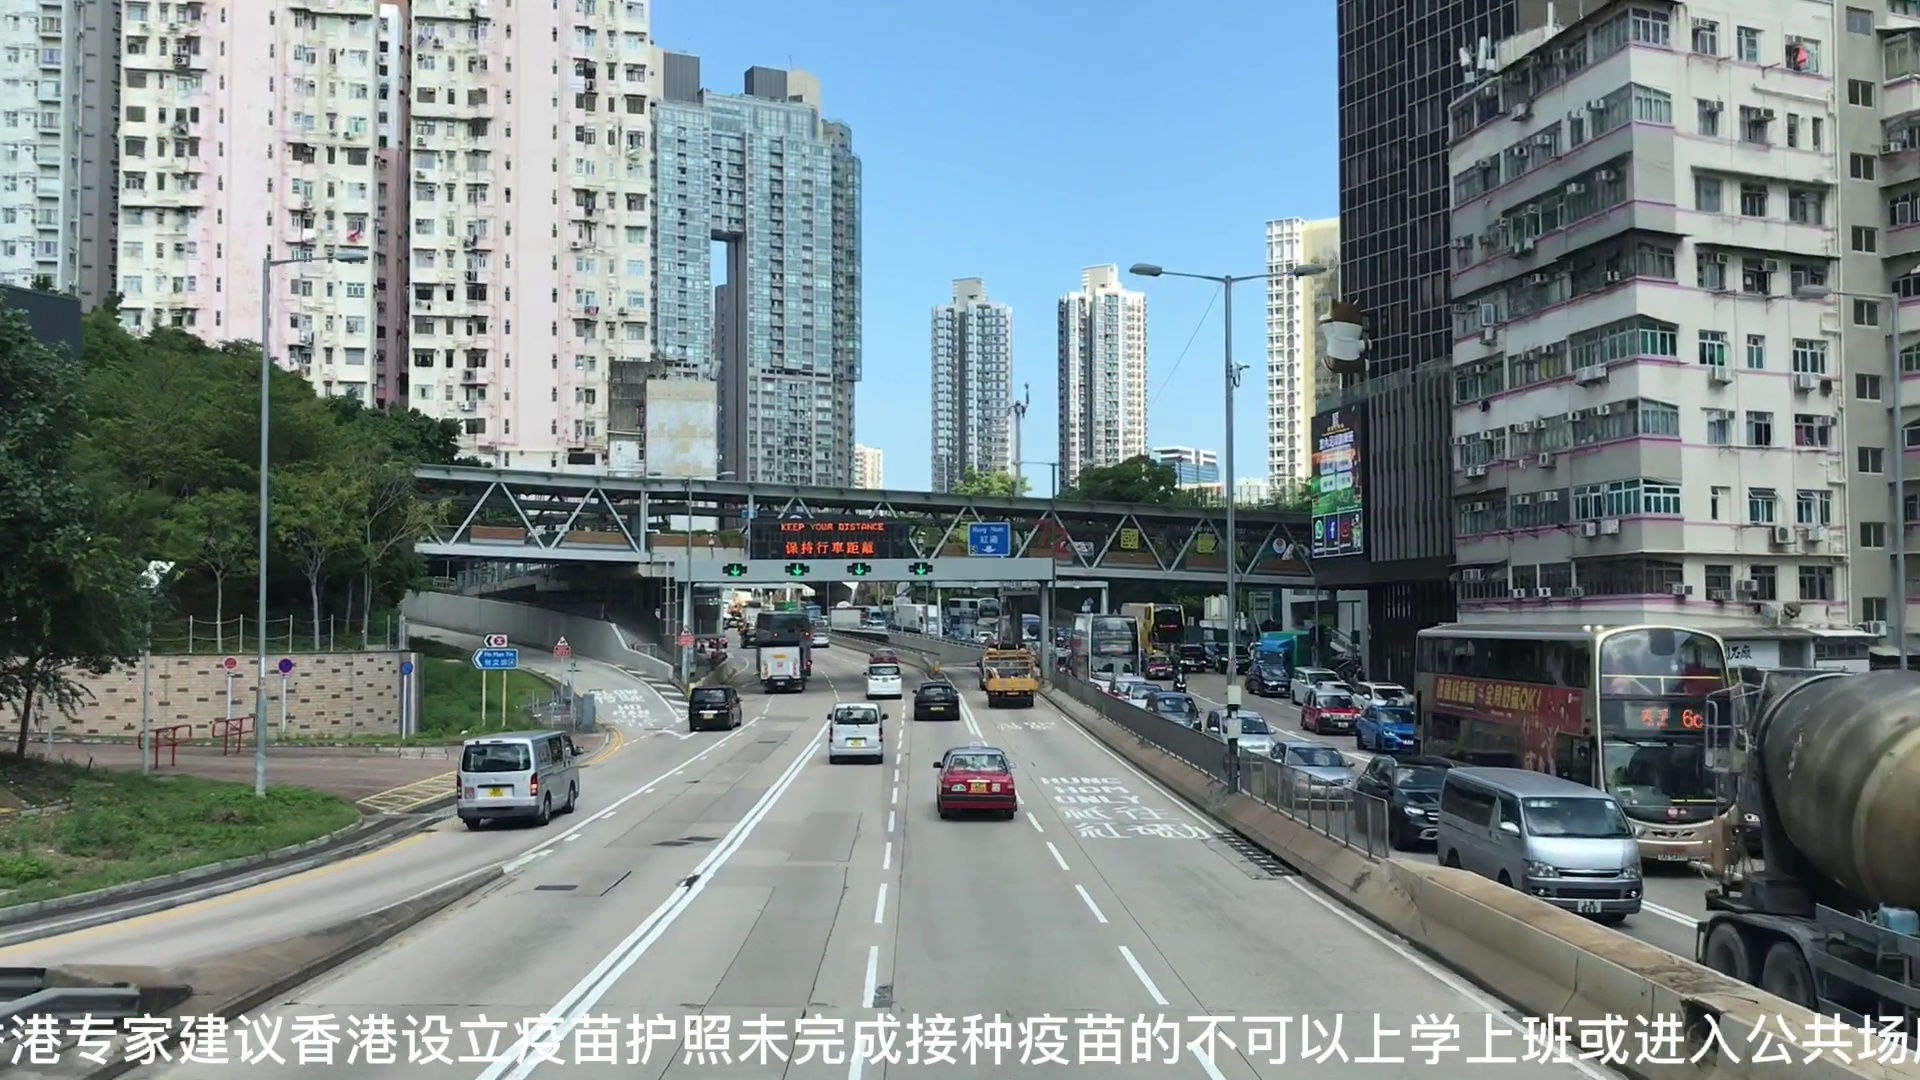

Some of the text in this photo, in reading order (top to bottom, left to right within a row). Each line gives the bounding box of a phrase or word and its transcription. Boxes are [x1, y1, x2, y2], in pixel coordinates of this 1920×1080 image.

[780, 522, 885, 532] KEEP YOUR DISTANCE
[784, 541, 876, 556] 保持行車距離
[1054, 786, 1131, 794] HOM
[1053, 795, 1141, 804] ONLY
